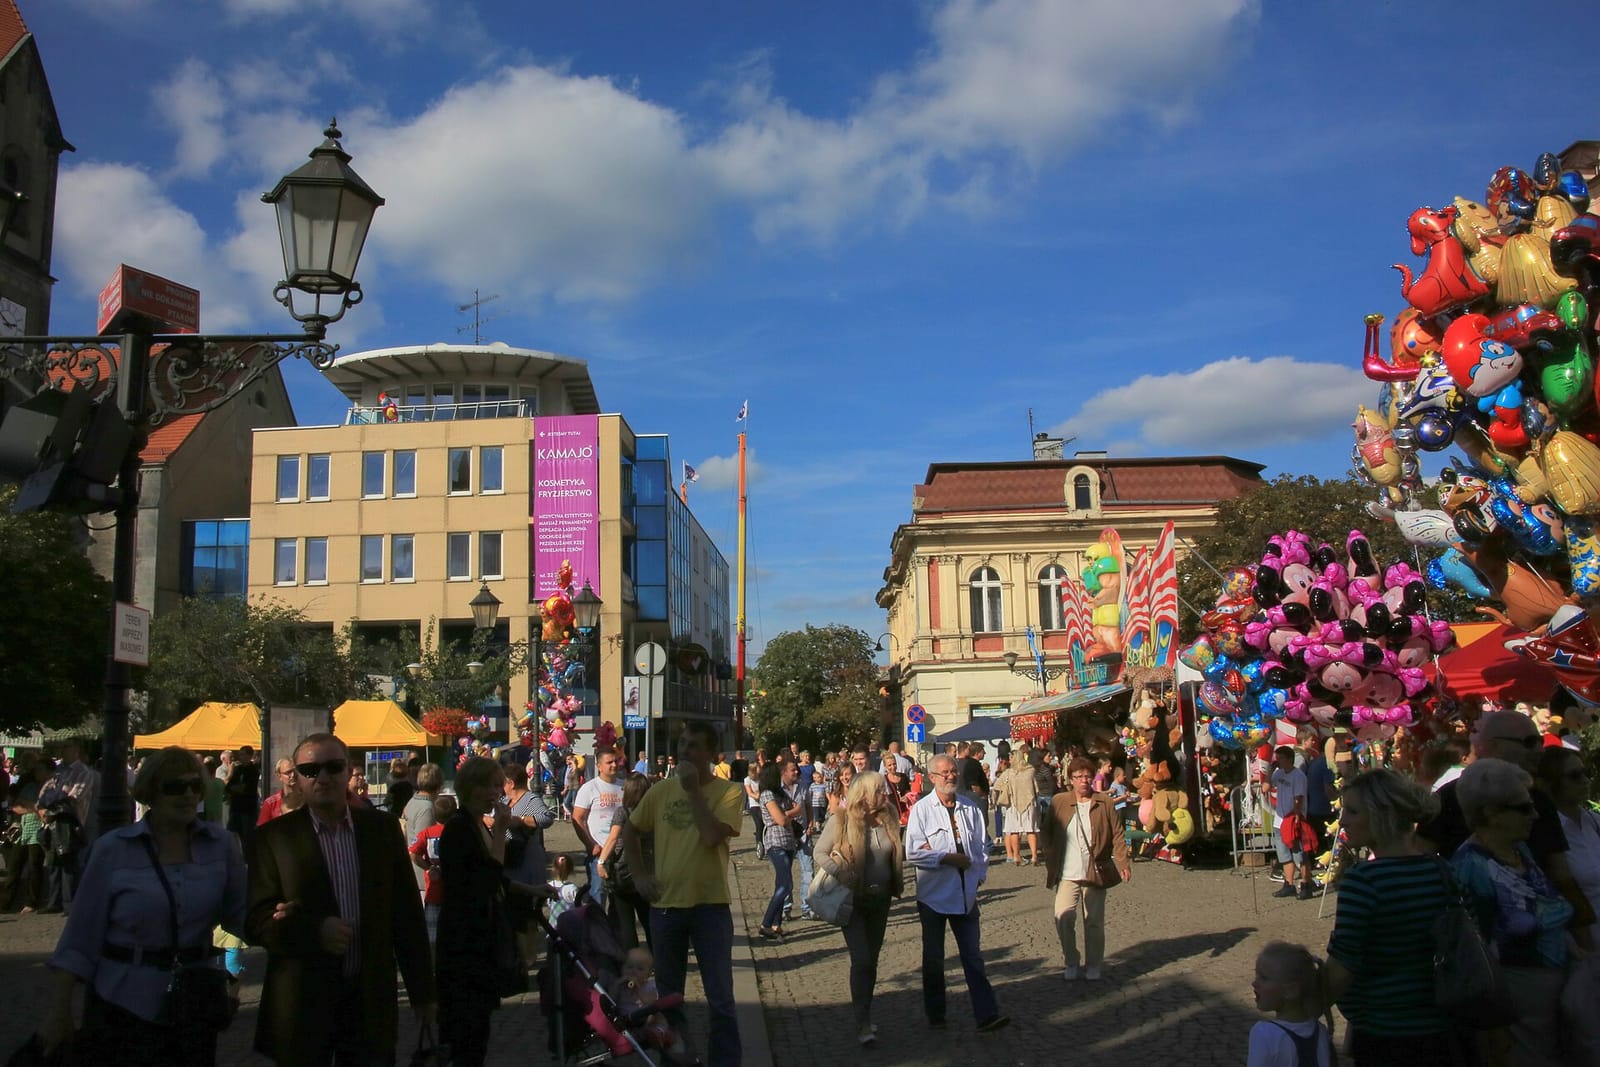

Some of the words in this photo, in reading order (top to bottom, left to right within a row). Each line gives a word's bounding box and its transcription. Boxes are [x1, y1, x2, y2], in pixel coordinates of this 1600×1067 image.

[141, 288, 155, 299] NIE
[538, 479, 585, 487] KOSMETYKA
[538, 489, 592, 498] FRYZJERSTWO
